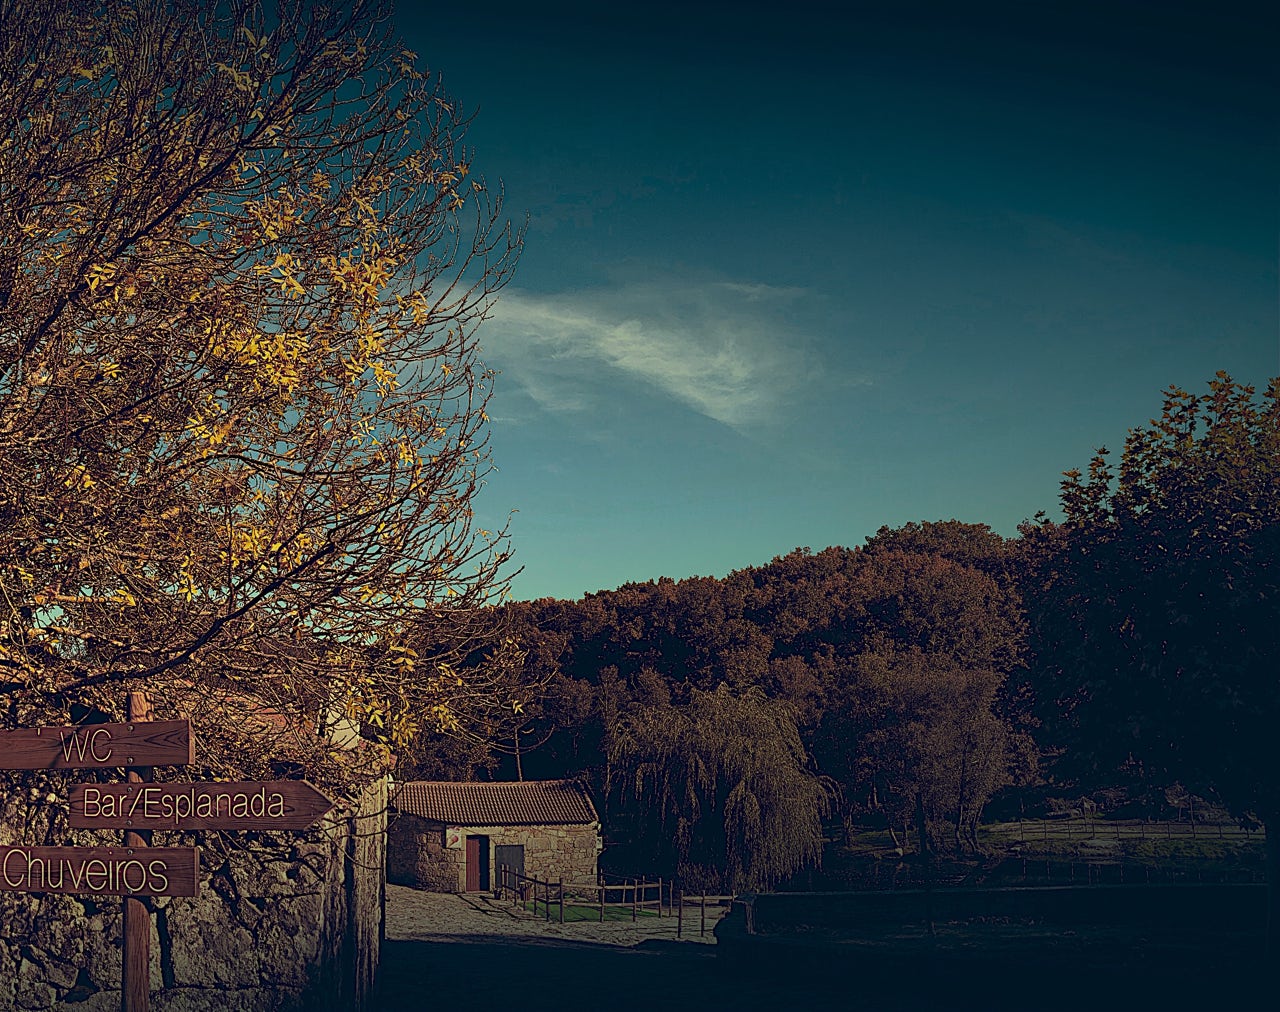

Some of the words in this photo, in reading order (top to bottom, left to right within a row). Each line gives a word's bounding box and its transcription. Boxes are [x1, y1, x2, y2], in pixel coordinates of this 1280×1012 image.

[60, 729, 112, 762] WC
[83, 787, 286, 825] Bar/Esplanada
[3, 849, 169, 892] Chuveiros
